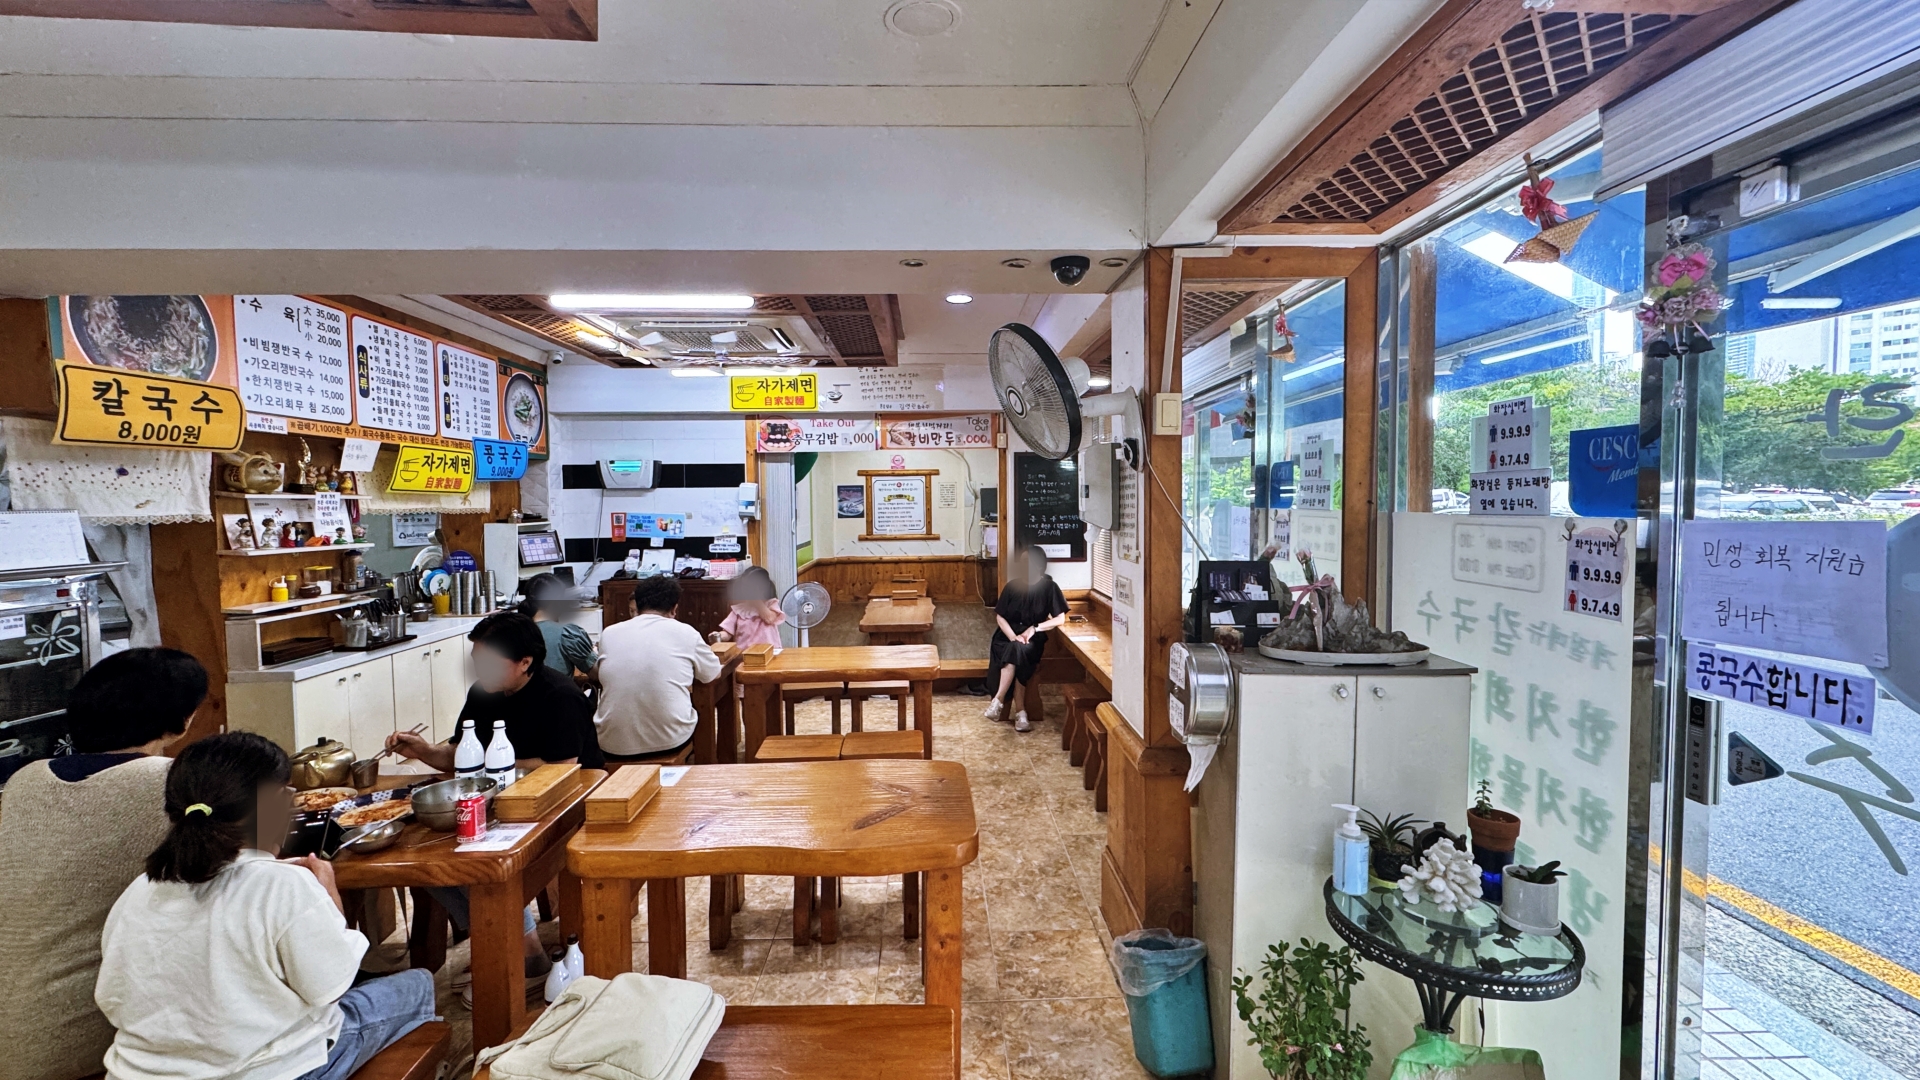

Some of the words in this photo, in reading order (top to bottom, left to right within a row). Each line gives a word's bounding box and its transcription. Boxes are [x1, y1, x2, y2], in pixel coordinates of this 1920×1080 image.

[304, 305, 312, 316] 大
[316, 308, 340, 323] 35,000
[304, 318, 312, 329] 中
[317, 321, 341, 336] 25,000
[304, 331, 313, 341] 小
[317, 334, 342, 348] 20,000
[414, 347, 428, 357] 7,000
[318, 355, 342, 368] 12,000
[414, 356, 428, 366] 7,000
[251, 357, 315, 379] 가오리쟁반국수
[319, 373, 344, 386] 14,000
[358, 351, 369, 391] 식사류
[375, 366, 410, 380] 가오리회국수
[415, 365, 428, 375] 7,000
[375, 376, 411, 390] 가오리물회국수
[413, 384, 429, 394] 10,000
[756, 377, 813, 393] 자가제면
[91, 378, 224, 426] 칼국수
[321, 389, 344, 401] 15,000
[413, 394, 429, 403] 10,000
[321, 404, 345, 416] 25,000
[414, 403, 430, 412] 11,000
[1493, 400, 1527, 416] 화장실비번
[809, 418, 834, 428] Take
[837, 418, 856, 428] Out
[966, 416, 990, 426] Take
[974, 424, 989, 432] Out
[118, 421, 202, 445] 8,000원
[344, 426, 357, 437] 추가
[397, 434, 408, 442] 국수
[791, 432, 839, 446] 충무김밥
[905, 431, 955, 447] 갈비만두
[1500, 424, 1531, 440] 9.9.9.9
[483, 444, 522, 466] 콩국수
[1589, 434, 1640, 462] CESC
[421, 452, 471, 475] 자가제면
[1499, 452, 1530, 467] 9.7.4.9
[491, 466, 515, 477] 9,000원
[1471, 477, 1501, 492] 화장실은
[1506, 476, 1550, 491] 둥지노래방
[1500, 498, 1538, 511] 있습니다.
[1575, 538, 1618, 557] 화장실비번
[1703, 539, 1742, 569] 민생
[1754, 544, 1791, 572] 회복
[1805, 546, 1866, 576] 지원금
[1583, 567, 1622, 585] 9.9.9.9
[1581, 597, 1620, 617] 9.7.4.9
[1714, 597, 1778, 635] 됩니다.
[1696, 651, 1864, 726] 콩국수합니다.
